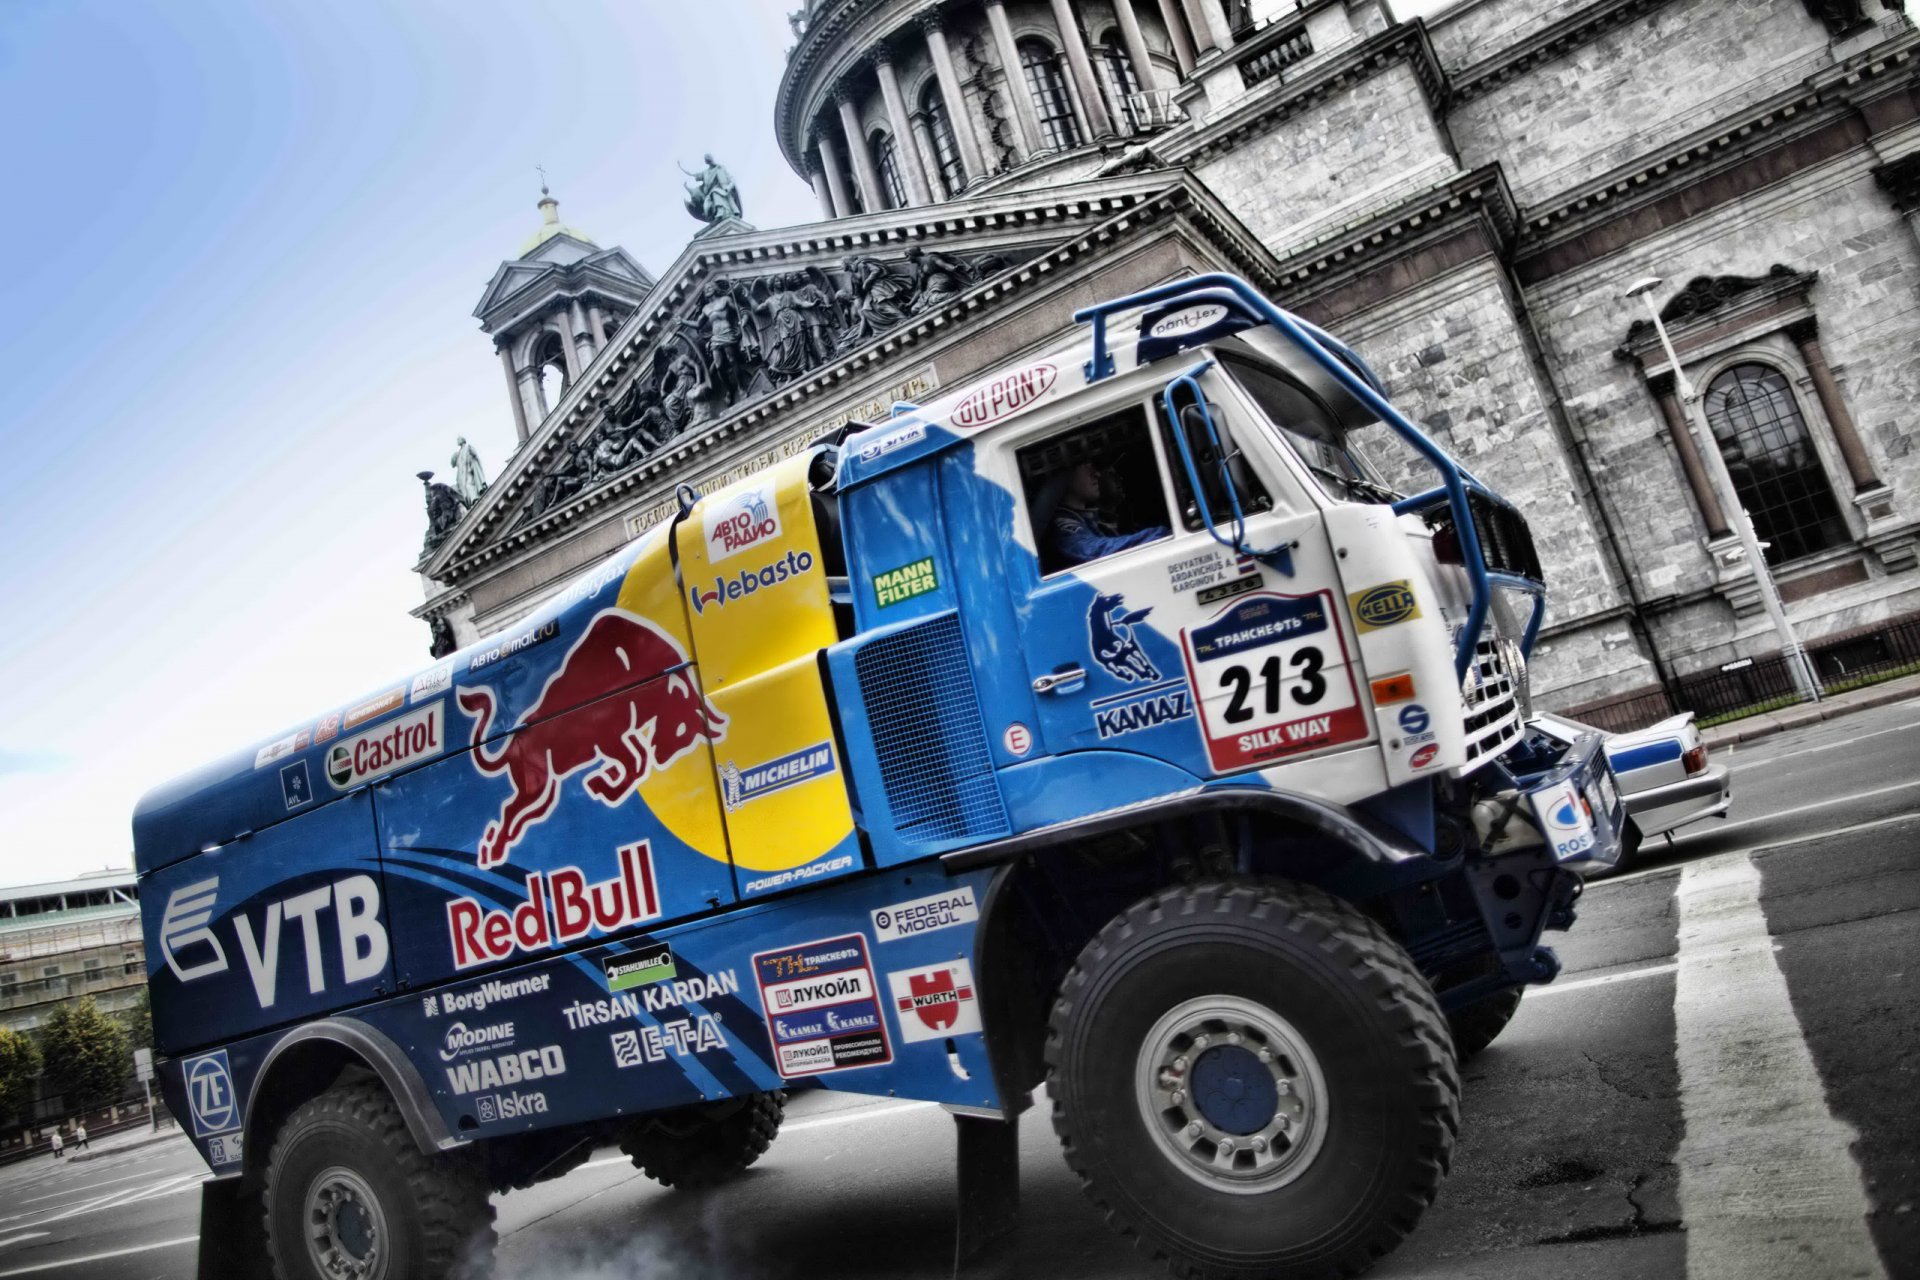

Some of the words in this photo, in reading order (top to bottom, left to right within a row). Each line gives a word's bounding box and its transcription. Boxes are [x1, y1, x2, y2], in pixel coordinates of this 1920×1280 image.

[711, 511, 751, 542] АВТО
[723, 518, 776, 552] РАДИО
[690, 548, 814, 616] Webasto
[874, 559, 933, 592] MANN
[877, 575, 938, 608] FILTER
[1361, 591, 1415, 617] HELLA
[1215, 617, 1302, 649] ТРАНСНЕФТЬ
[1219, 645, 1327, 725] 213
[1097, 692, 1193, 739] KAMAZ
[354, 711, 437, 776] Castrol
[1010, 729, 1025, 749] E
[1238, 727, 1284, 752] SILK
[1286, 716, 1332, 741] WAY
[744, 749, 829, 791] MICHELIN
[746, 855, 853, 893] POWER-PACKER
[447, 871, 552, 971] Red
[549, 838, 662, 941] Bull
[894, 895, 973, 923] FEDERAL
[897, 912, 961, 935] MOGUL
[232, 874, 389, 1009] VTB
[804, 948, 859, 966] ТРАНСНЕФТЬ
[618, 956, 663, 975] STAHLWILLE
[442, 973, 550, 1014] BorgWarner
[643, 968, 739, 1012] KARDAN
[793, 977, 861, 1004] ЛУКОЙЛ
[447, 1021, 515, 1050] MODINE
[789, 1023, 823, 1037] KAMAZ
[840, 1014, 875, 1029] KAMAZ
[793, 1045, 830, 1059] ЛУКОЙЛ
[446, 1044, 567, 1096] WABCO
[191, 1069, 231, 1117] ZF
[496, 1091, 549, 1119] Iskra
